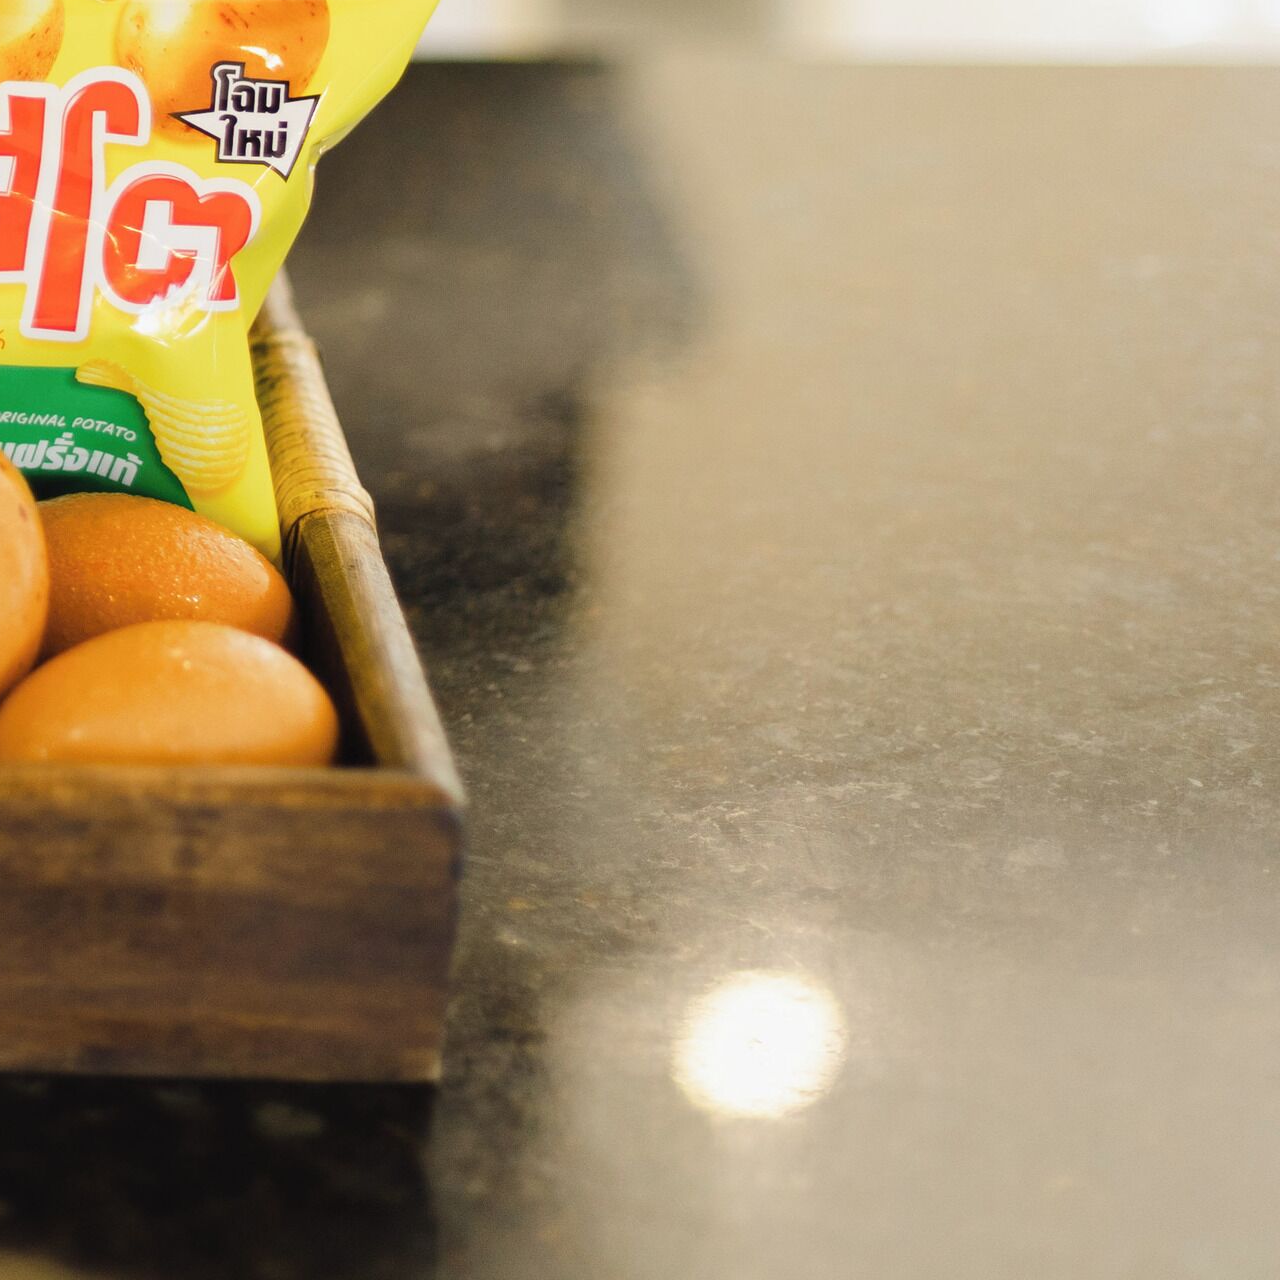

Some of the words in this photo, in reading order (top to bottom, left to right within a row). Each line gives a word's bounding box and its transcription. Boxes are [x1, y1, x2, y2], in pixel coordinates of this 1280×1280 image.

[217, 68, 282, 114] โฉม
[218, 113, 289, 159] ใหม่
[72, 416, 138, 442] POTATO
